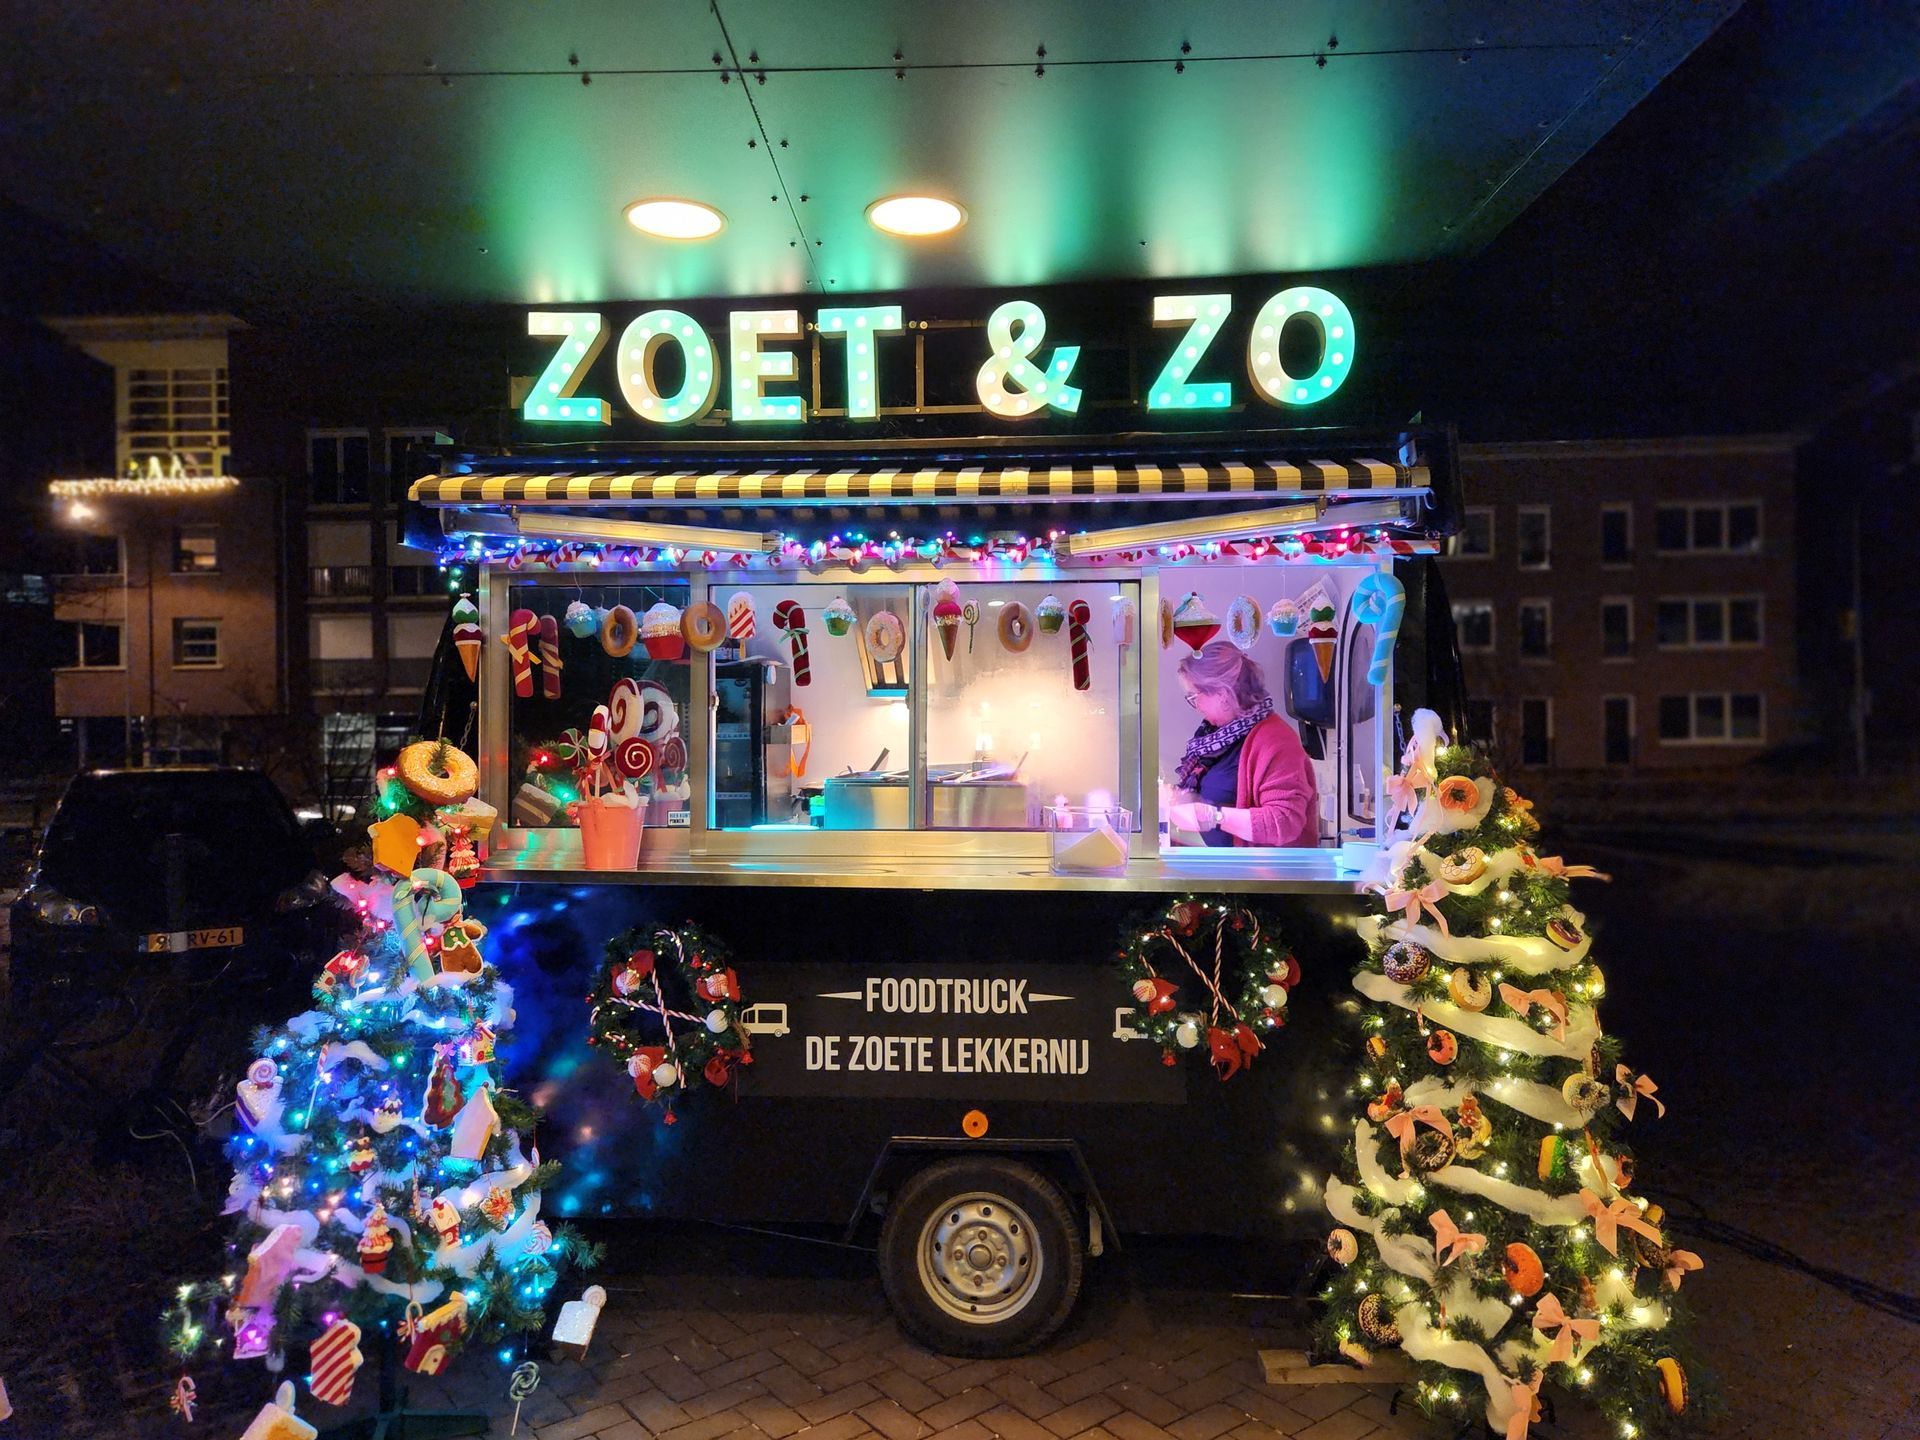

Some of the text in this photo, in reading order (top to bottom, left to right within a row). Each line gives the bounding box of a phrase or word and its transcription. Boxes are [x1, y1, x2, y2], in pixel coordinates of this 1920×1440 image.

[524, 286, 1356, 424] ZOET & ZO
[866, 977, 1028, 1014] FOODTRUCK
[805, 1035, 1090, 1075] DE ZOETE LEKKERNIJ
